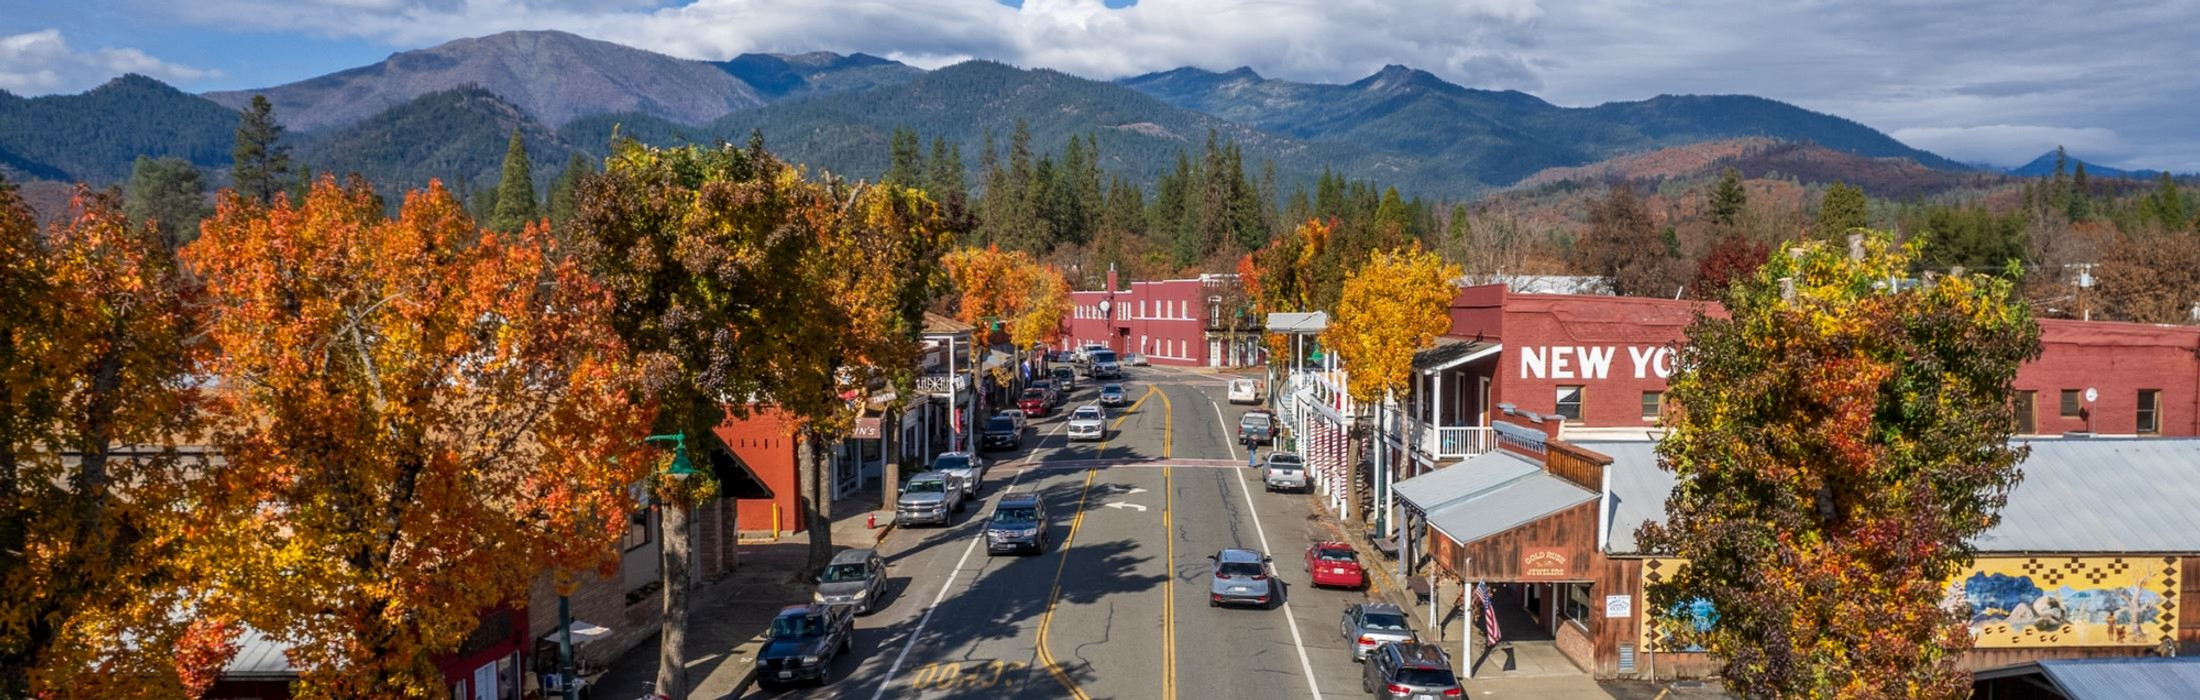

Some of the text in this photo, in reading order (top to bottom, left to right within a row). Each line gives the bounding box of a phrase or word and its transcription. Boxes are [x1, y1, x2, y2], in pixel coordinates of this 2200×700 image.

[1520, 346, 1615, 379] NEW
[1525, 551, 1566, 565] GOLD RUSH
